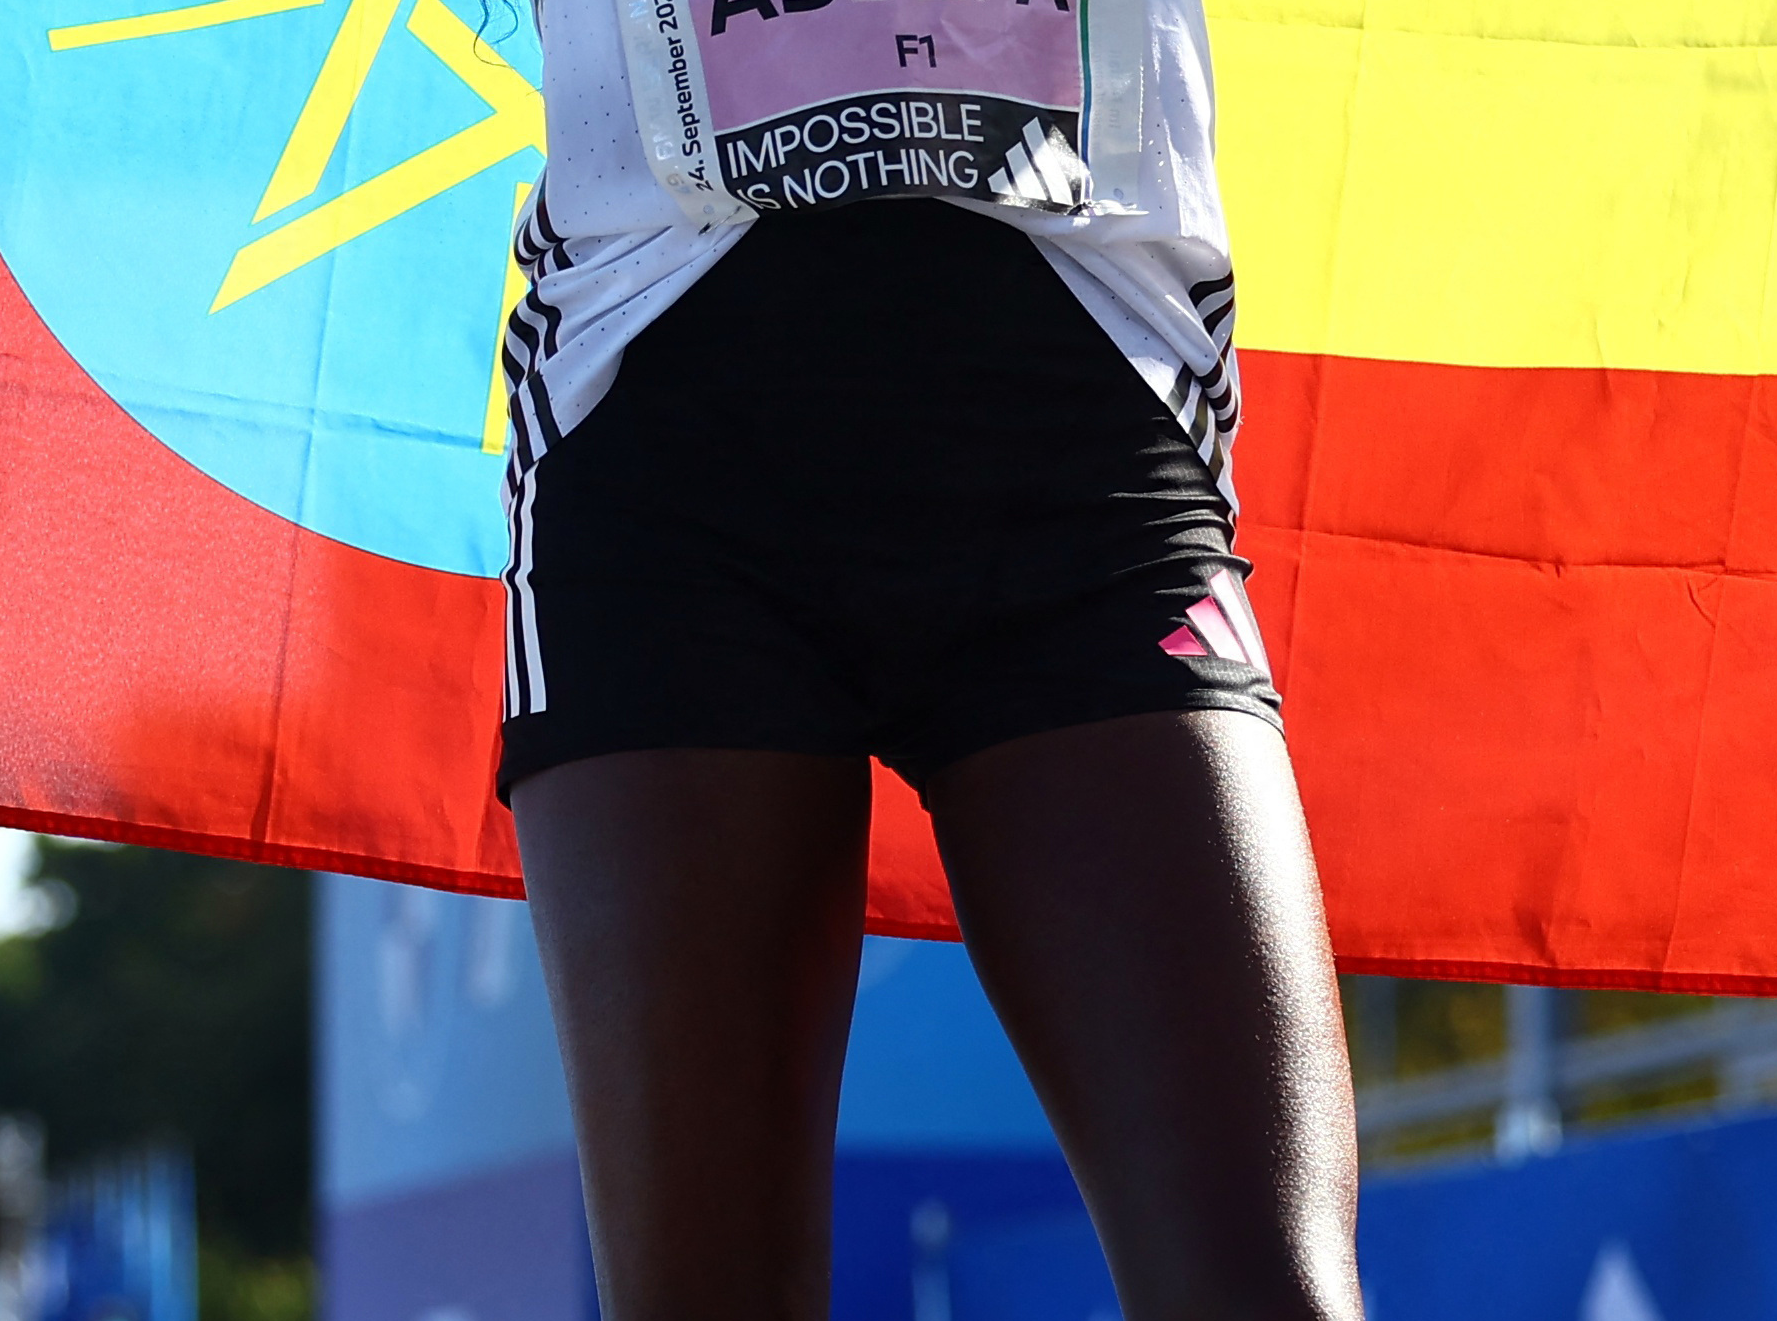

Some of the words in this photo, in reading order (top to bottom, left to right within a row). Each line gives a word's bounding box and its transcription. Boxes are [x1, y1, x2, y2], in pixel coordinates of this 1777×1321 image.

[895, 34, 937, 68] F1
[668, 36, 702, 157] September
[726, 102, 984, 178] IMPOSSIBLE
[687, 160, 714, 192] 24.
[736, 184, 782, 210] IS
[783, 149, 979, 209] NOTHING
